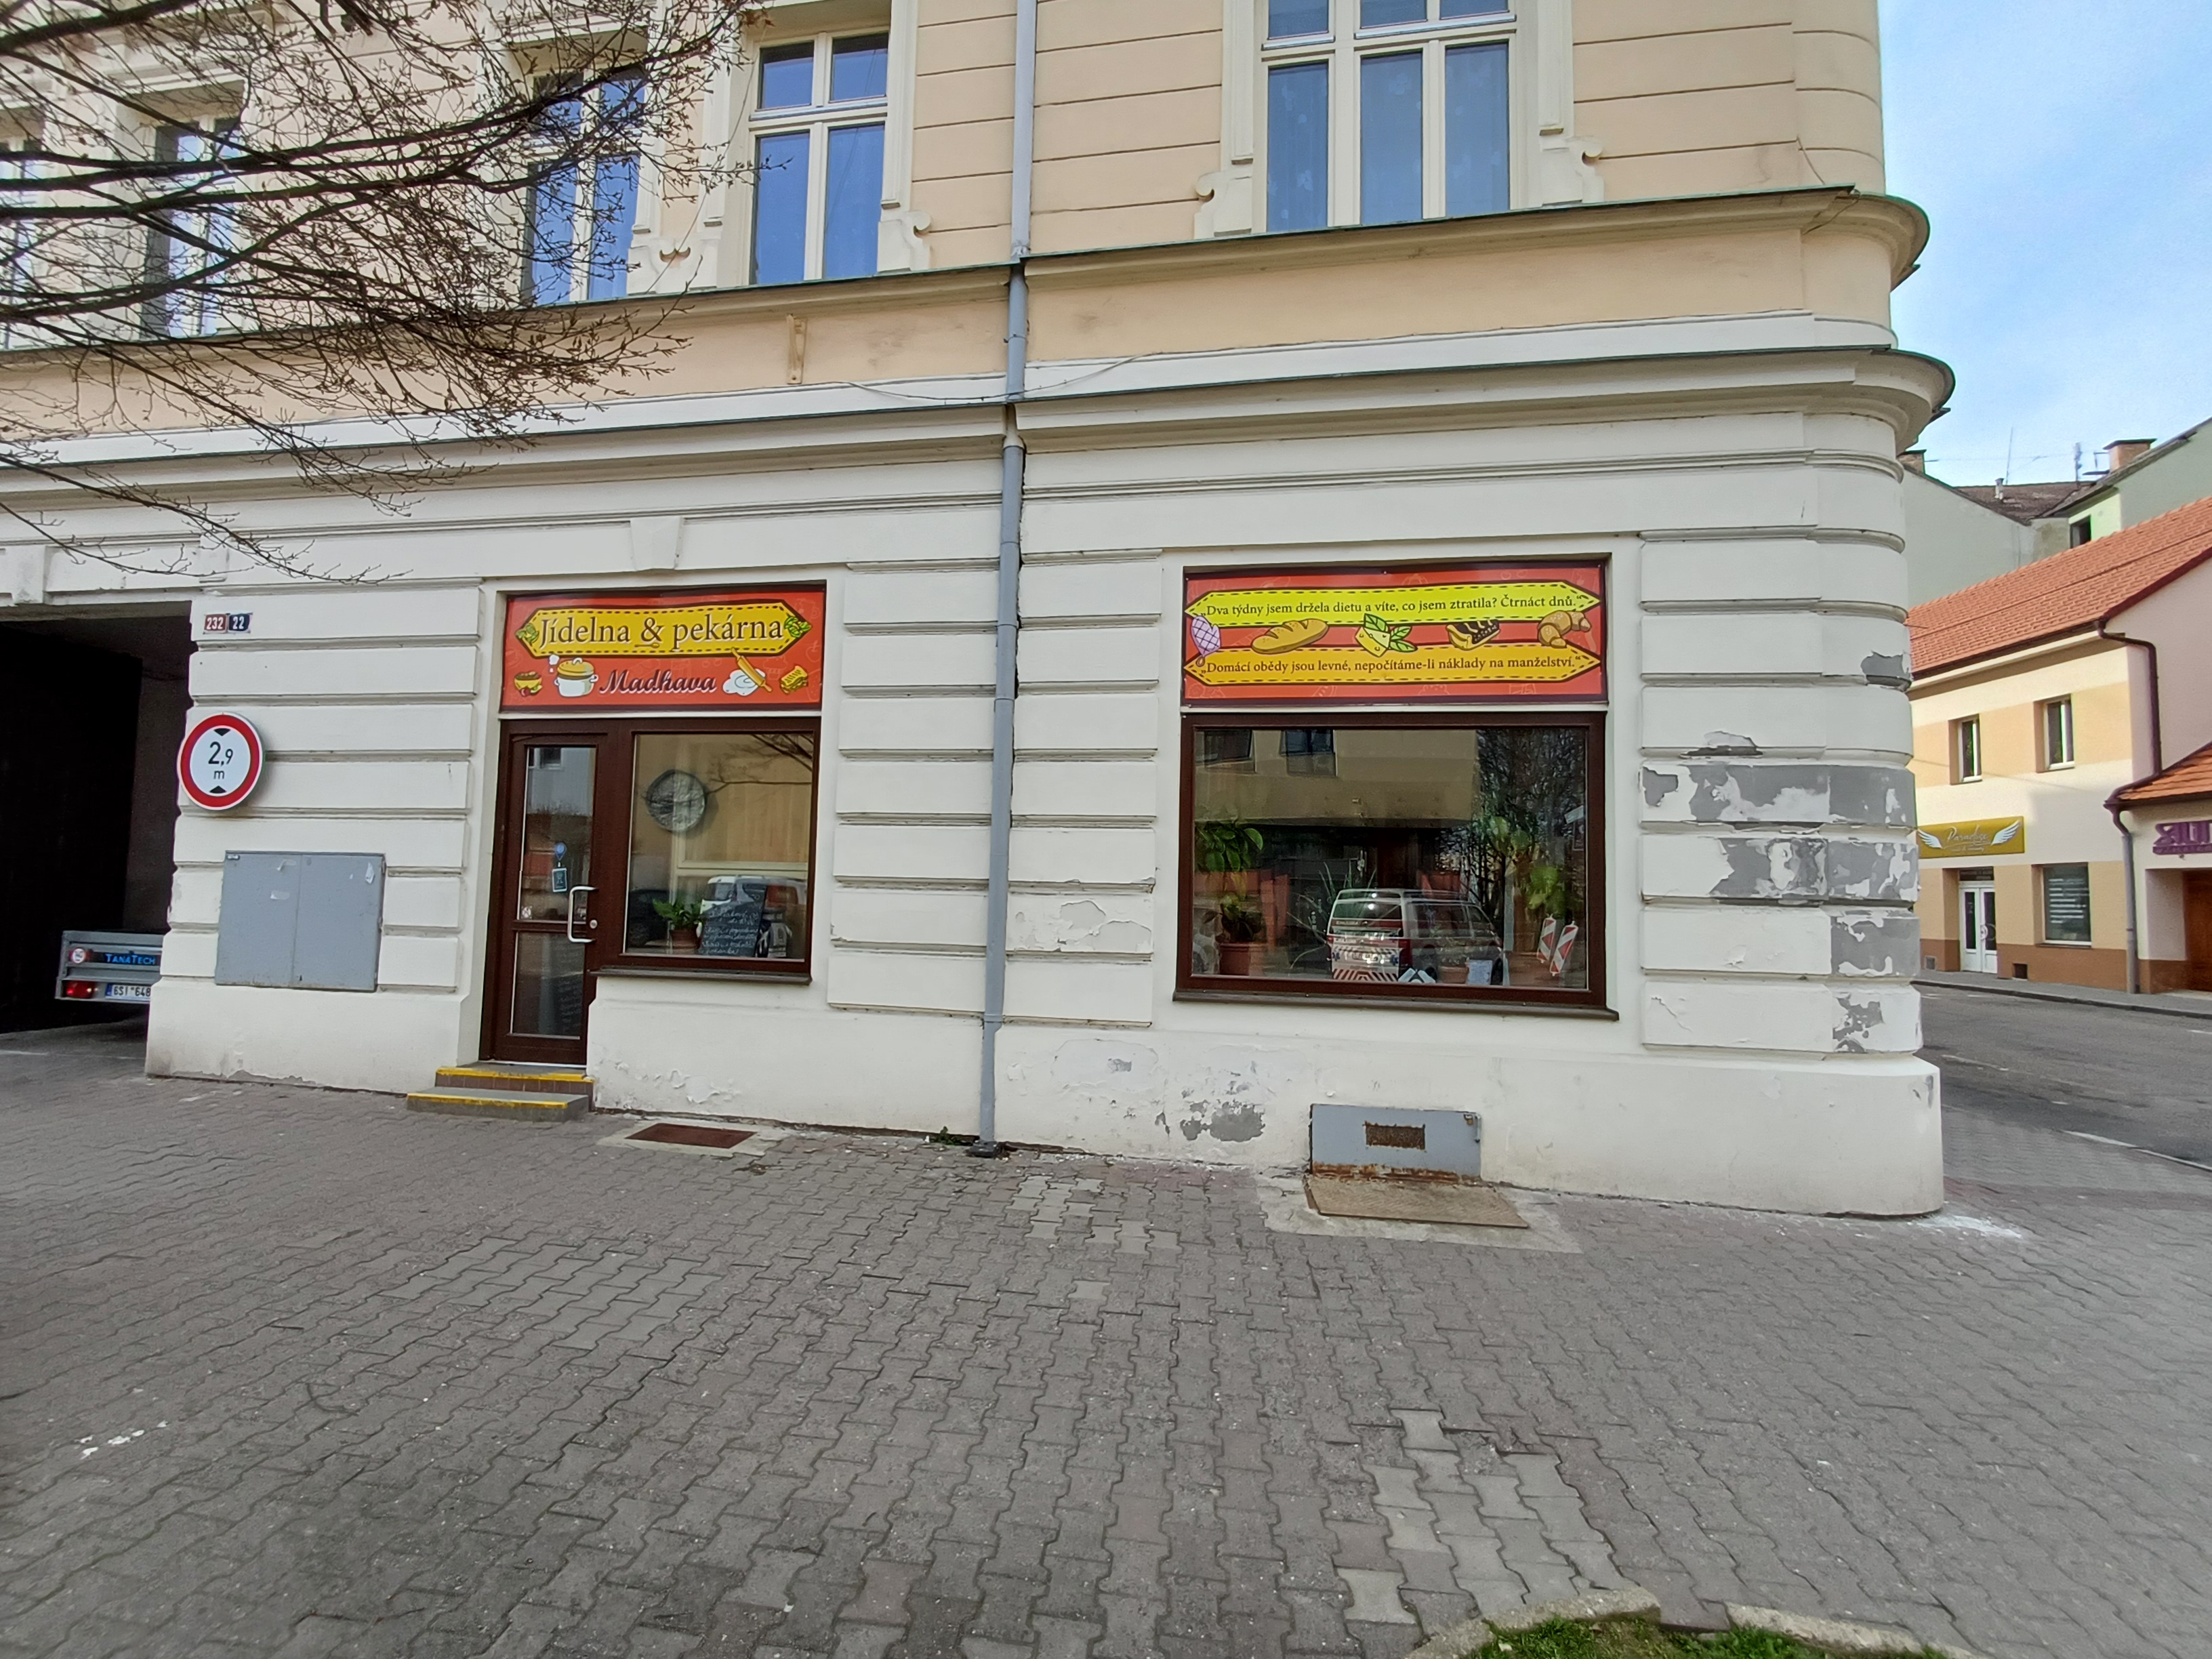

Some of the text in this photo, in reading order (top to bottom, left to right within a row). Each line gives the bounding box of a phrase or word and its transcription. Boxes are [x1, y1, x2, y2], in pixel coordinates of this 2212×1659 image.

[1233, 602, 1263, 617] týdny
[1265, 603, 1292, 616] jsem
[1296, 602, 1330, 613] držela
[1333, 600, 1361, 613] dietu
[1365, 604, 1372, 612] a
[1374, 600, 1399, 613] víte,
[1402, 602, 1416, 611] co
[1418, 600, 1446, 614] jsem
[1450, 597, 1497, 610] ztratila?
[1500, 594, 1545, 608] Čtrnáct
[206, 618, 224, 630] 232
[232, 617, 245, 630] 22
[539, 613, 784, 651] Jídelna & pekárna
[1253, 659, 1289, 674] obědy
[1290, 660, 1315, 673] jsou
[1318, 659, 1351, 672] levné,
[1355, 657, 1435, 673] nepočítáme-li
[1438, 657, 1486, 672] náklady
[1489, 660, 1504, 669] na
[599, 668, 718, 695] Madhava
[208, 741, 234, 766] 2,9
[213, 770, 225, 780] m
